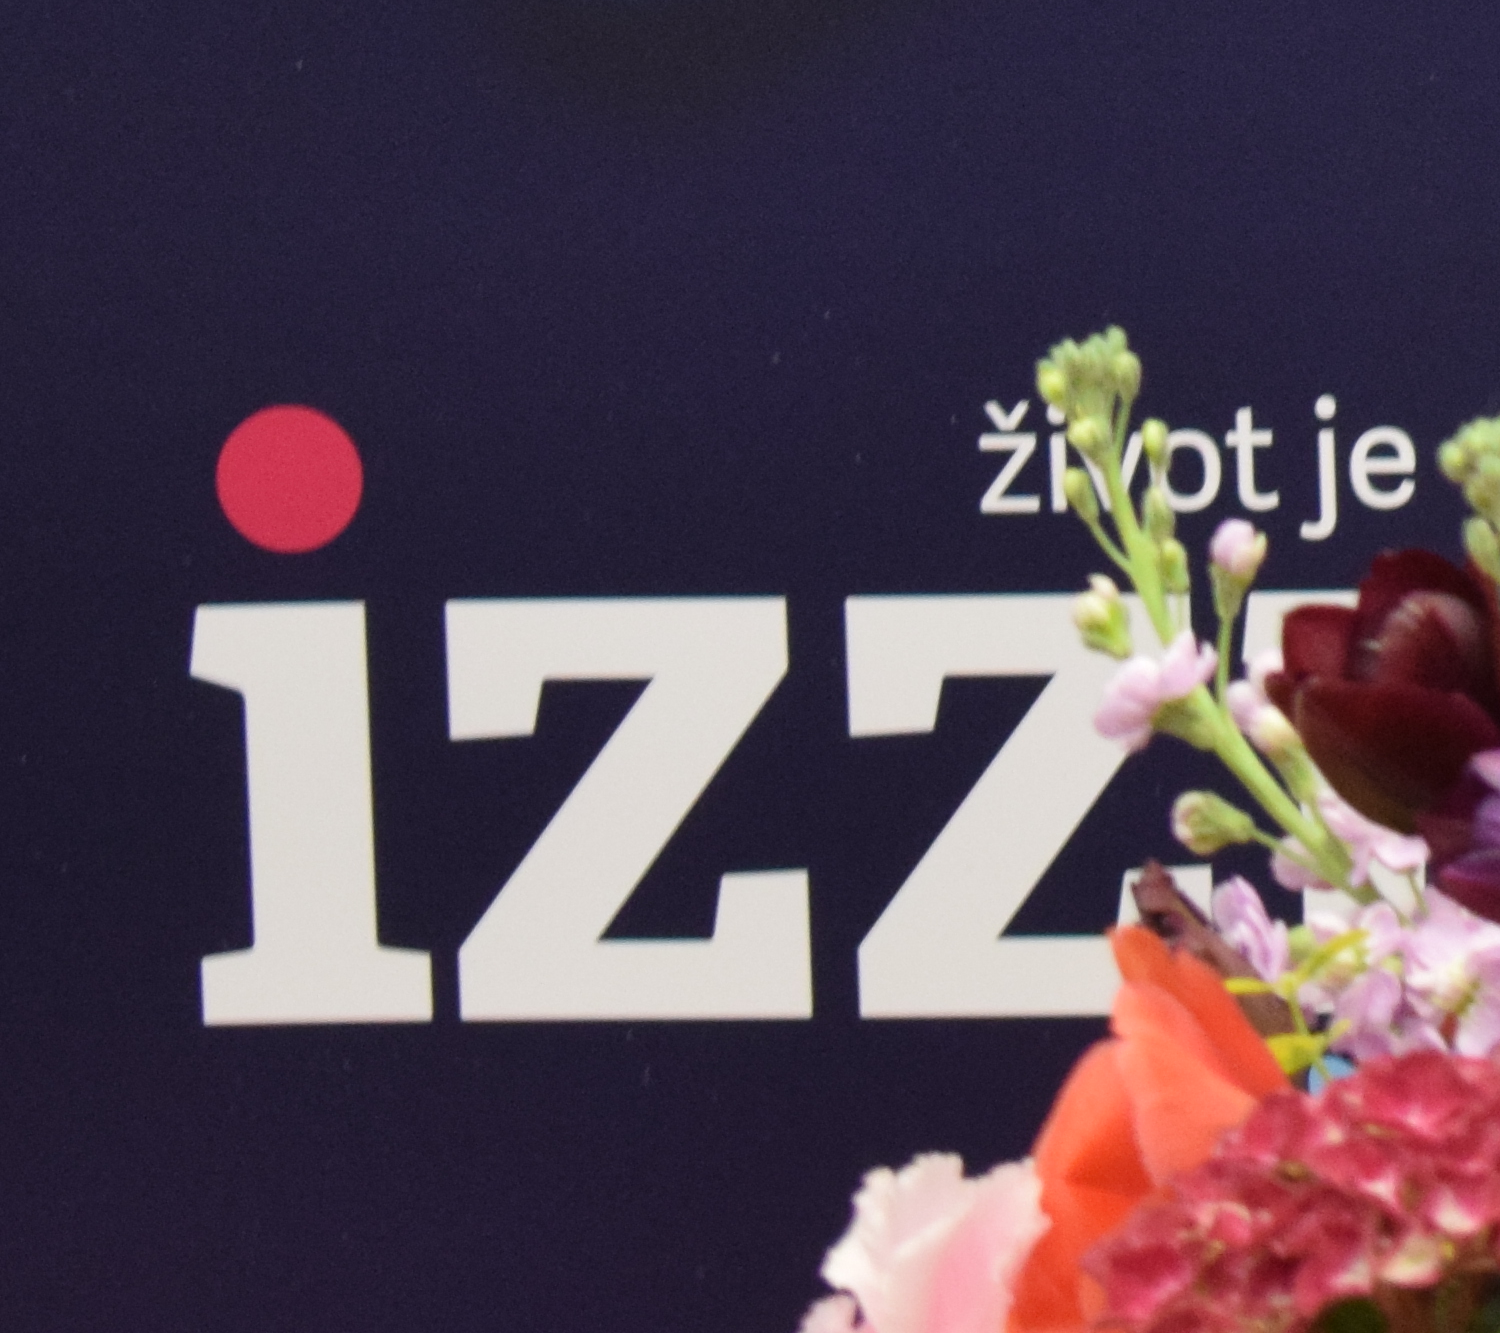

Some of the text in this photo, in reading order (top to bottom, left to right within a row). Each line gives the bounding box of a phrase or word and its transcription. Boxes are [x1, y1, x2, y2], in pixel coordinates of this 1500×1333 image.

[979, 393, 1418, 541] život je
[190, 403, 1430, 1025] izz
